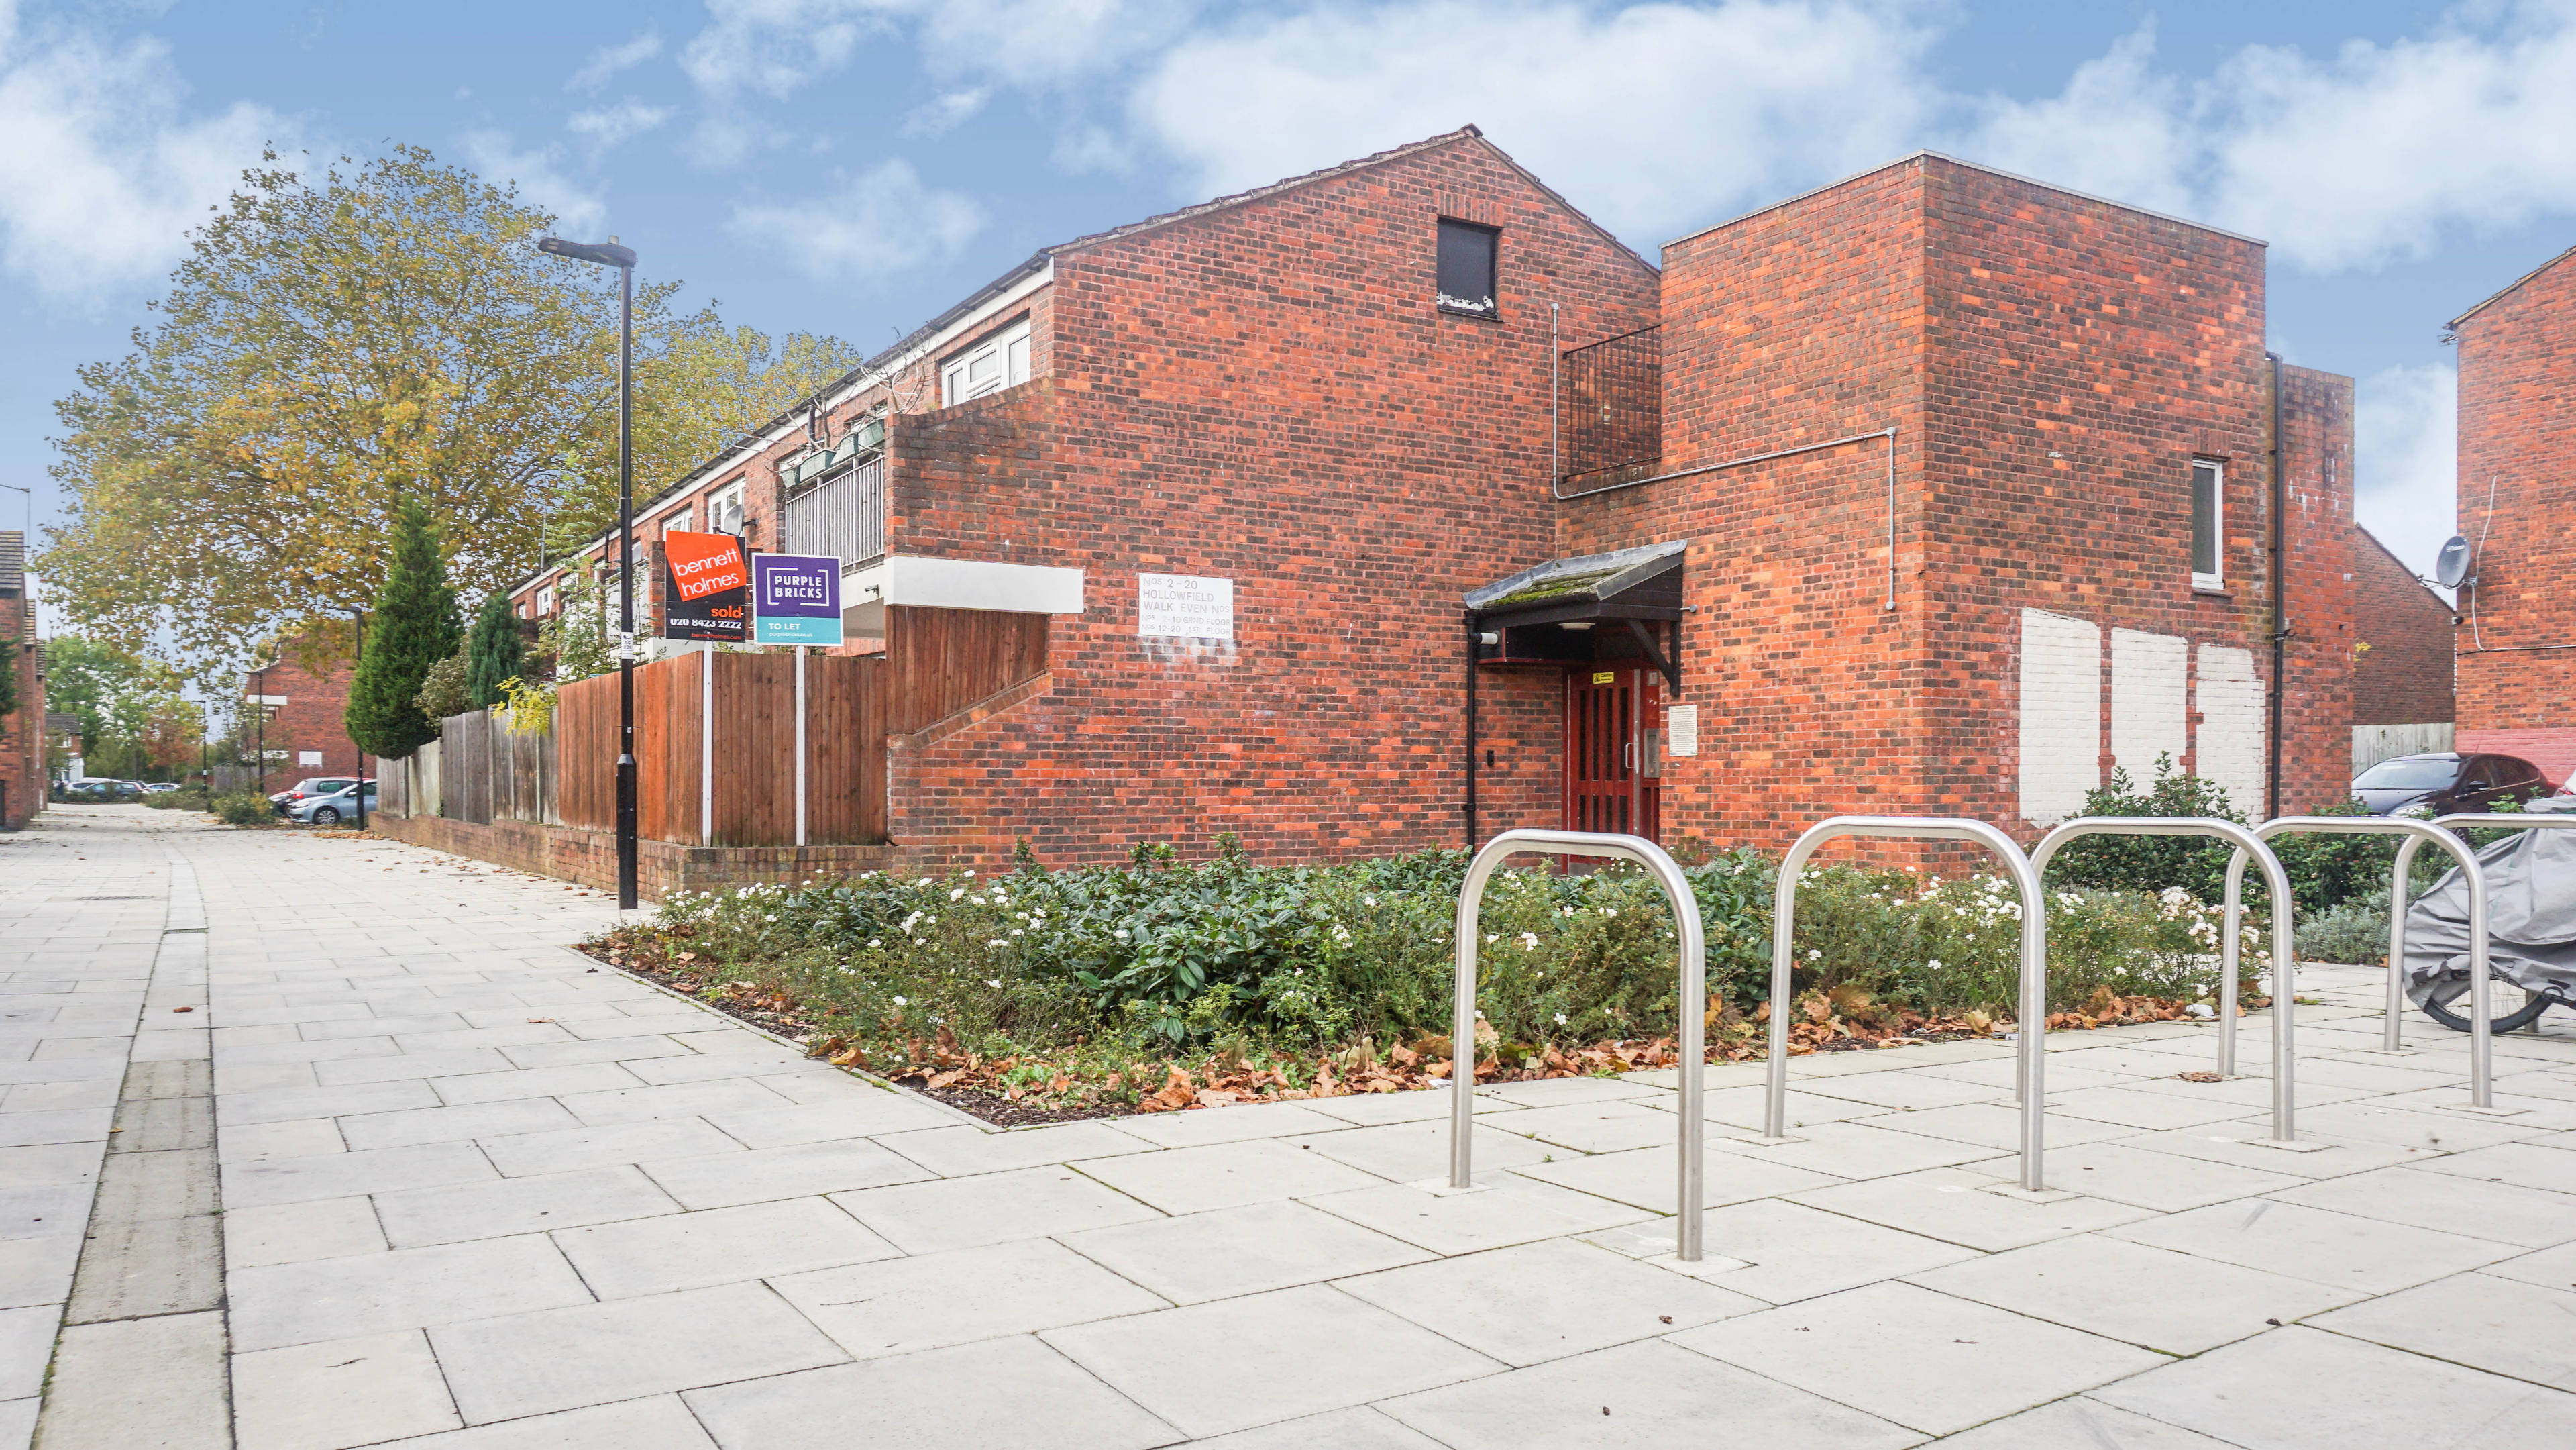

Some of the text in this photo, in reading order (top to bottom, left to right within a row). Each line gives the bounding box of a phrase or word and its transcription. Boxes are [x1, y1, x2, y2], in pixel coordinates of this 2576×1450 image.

[674, 548, 738, 576] bennett
[681, 573, 739, 597] holmes
[774, 575, 822, 586] PURPLE
[775, 587, 822, 599] BRICKS
[1142, 589, 1214, 602] HOLLOWFIELD
[711, 605, 742, 618] sold
[1143, 601, 1173, 612] WALK
[1180, 603, 1208, 613] EVEN
[670, 618, 742, 629] 020 8423 2222
[1206, 618, 1231, 626] FLOOR
